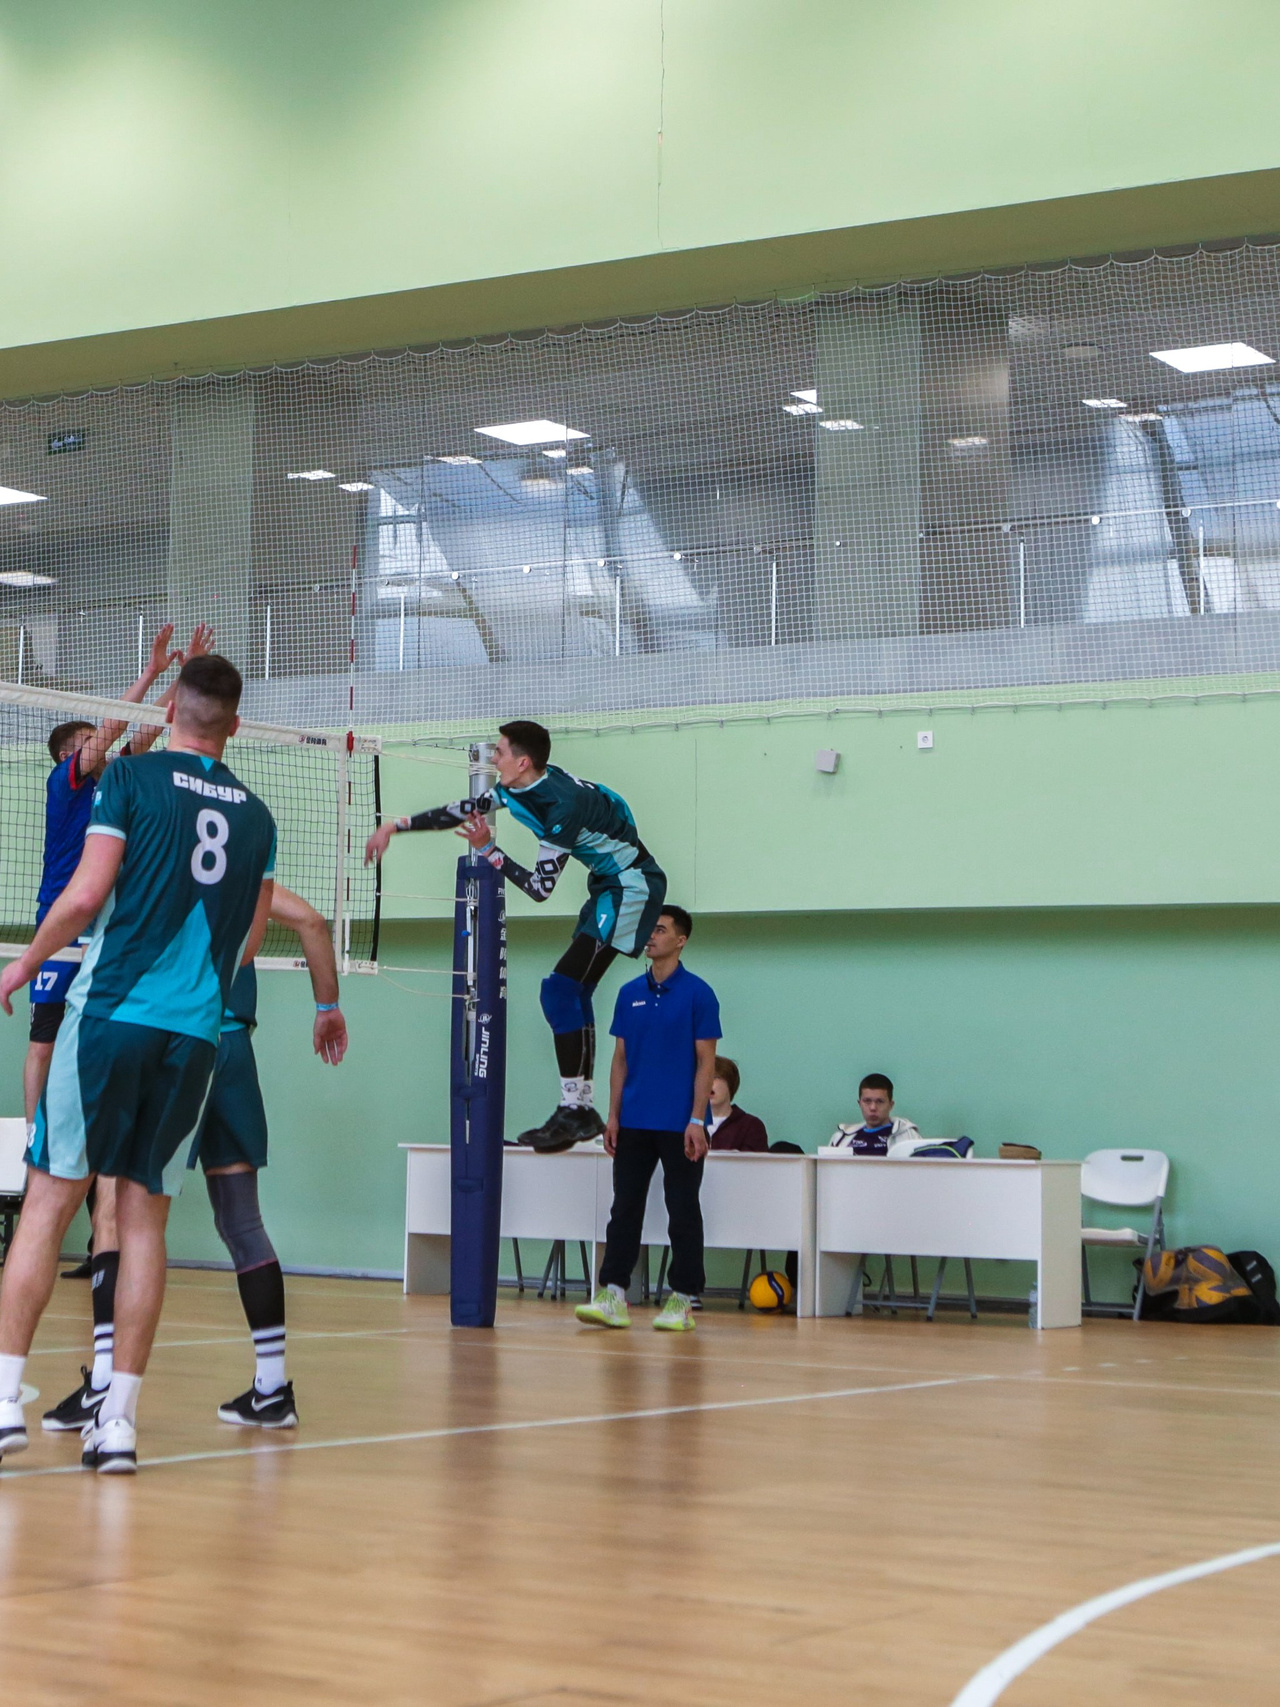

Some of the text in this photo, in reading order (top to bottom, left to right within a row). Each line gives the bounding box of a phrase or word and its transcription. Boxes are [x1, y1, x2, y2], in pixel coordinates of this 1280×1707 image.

[172, 771, 247, 804] СИБУР
[190, 808, 229, 885] 8
[34, 971, 58, 991] 17
[478, 1026, 490, 1079] JINLING
